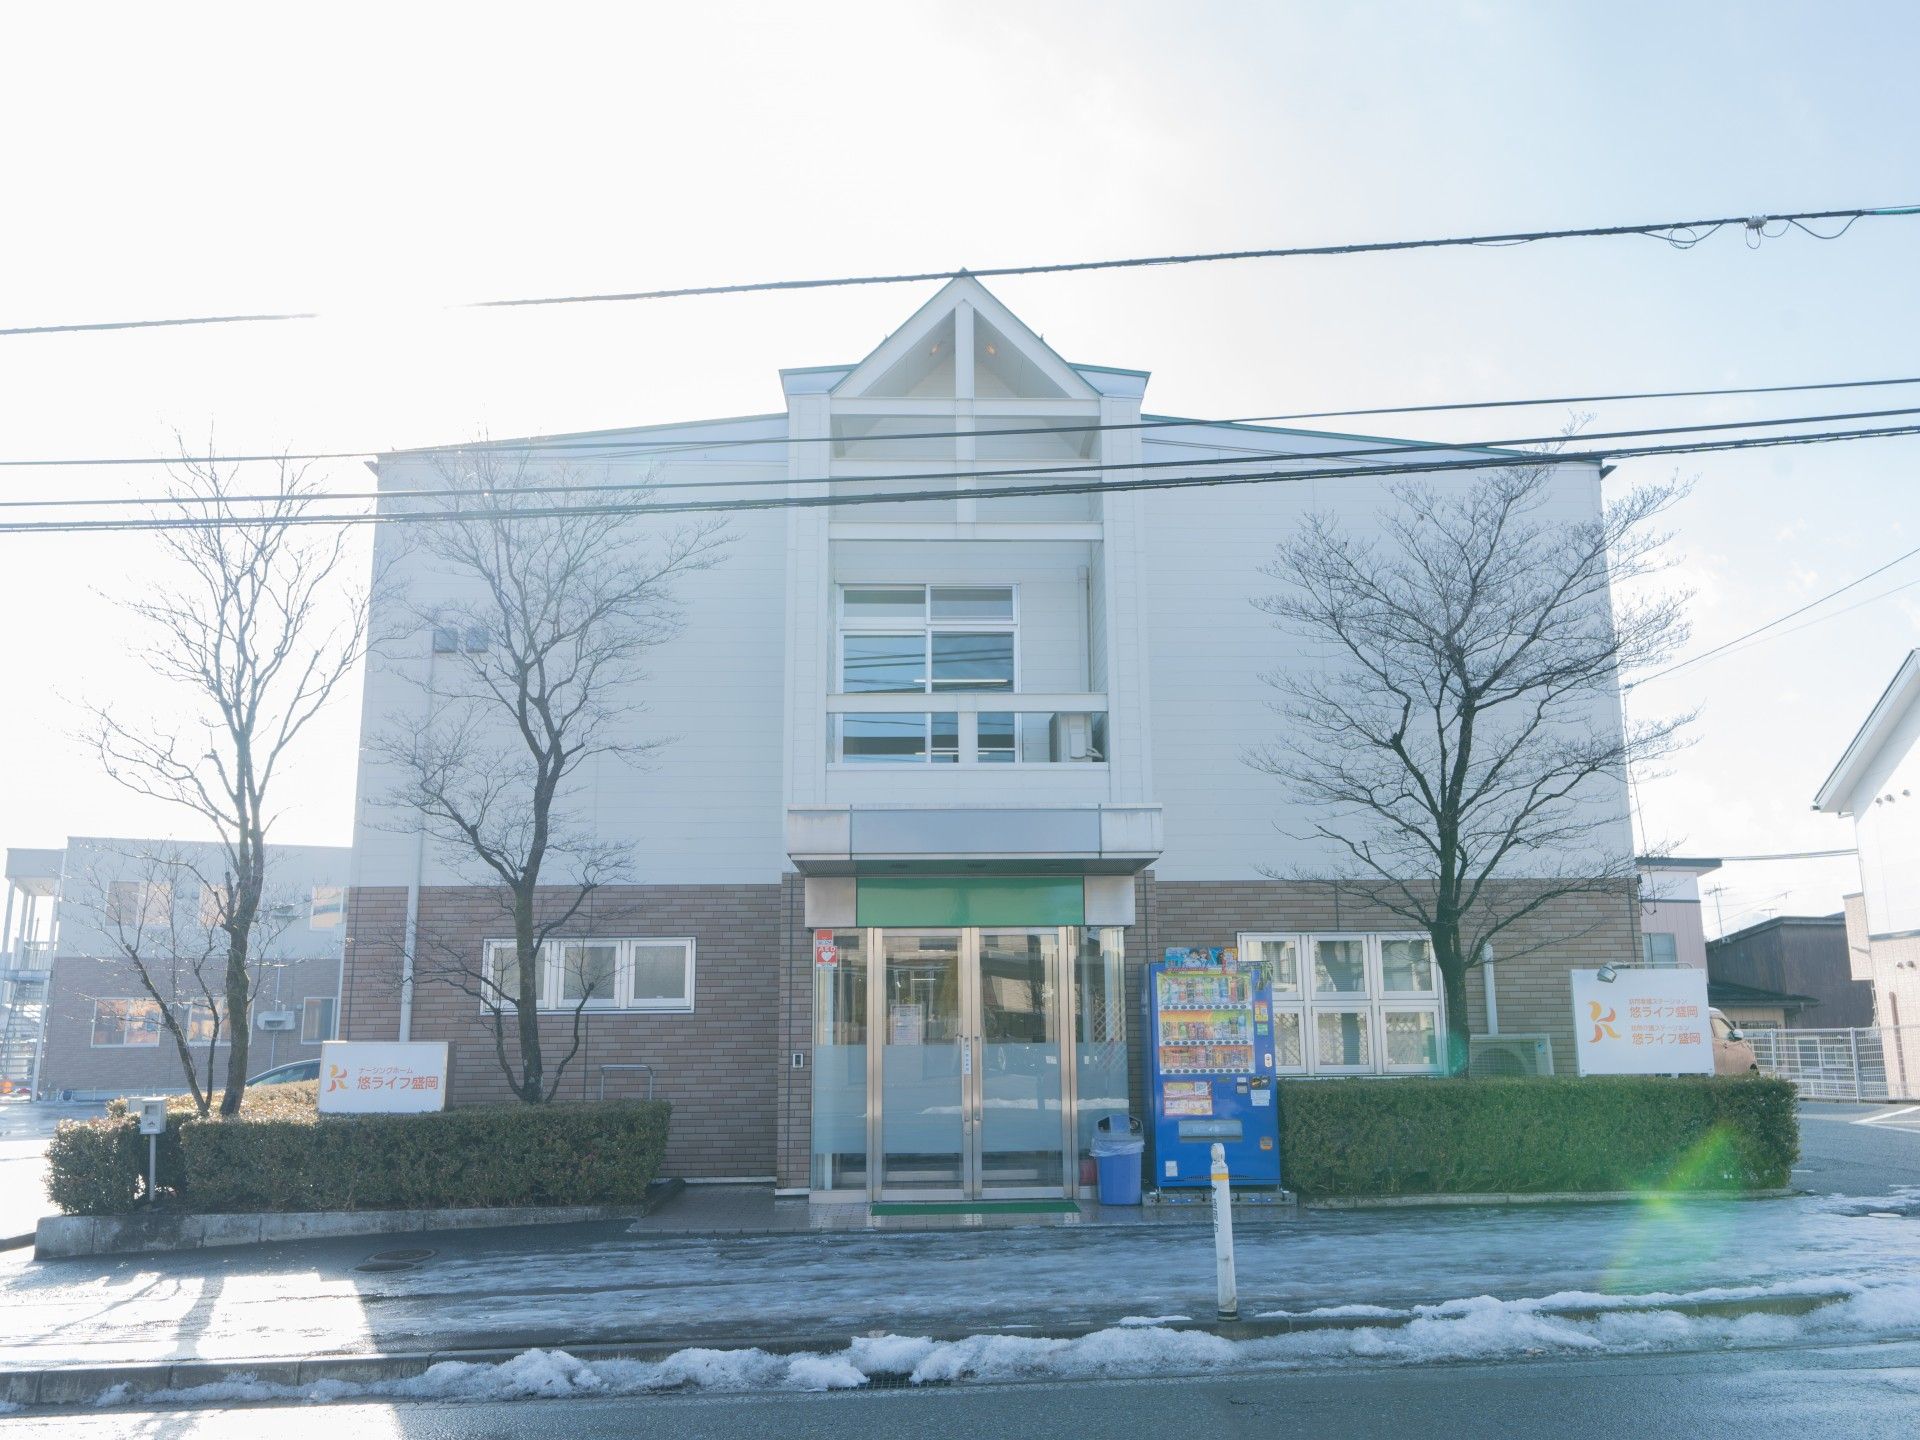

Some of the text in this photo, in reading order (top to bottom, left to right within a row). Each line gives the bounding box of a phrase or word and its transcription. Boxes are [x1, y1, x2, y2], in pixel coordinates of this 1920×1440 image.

[1630, 1006, 1698, 1018] 悠ライフ盛岡
[1632, 1032, 1700, 1045] 悠ライフ盛岡
[358, 1076, 438, 1089] 悠ライフ盛岡
